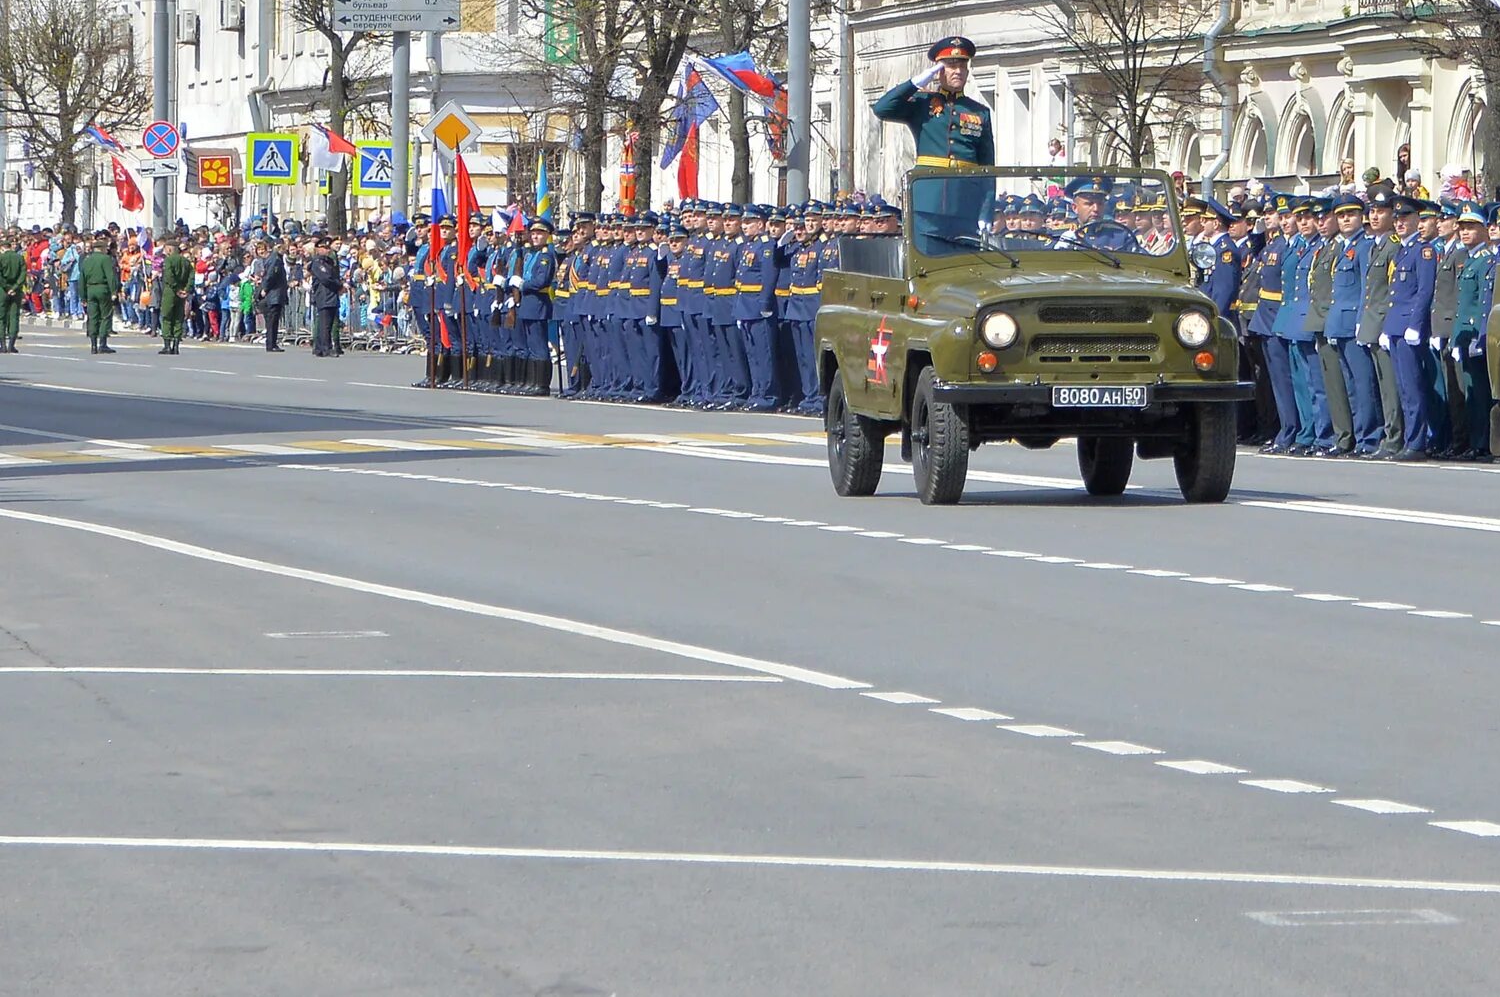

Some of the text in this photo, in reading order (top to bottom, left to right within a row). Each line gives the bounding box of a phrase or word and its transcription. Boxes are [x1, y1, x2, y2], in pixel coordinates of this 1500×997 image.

[352, 13, 422, 22] СТУДЕНЧЕСКИЙ
[1059, 387, 1141, 404] 8080 АН 50
